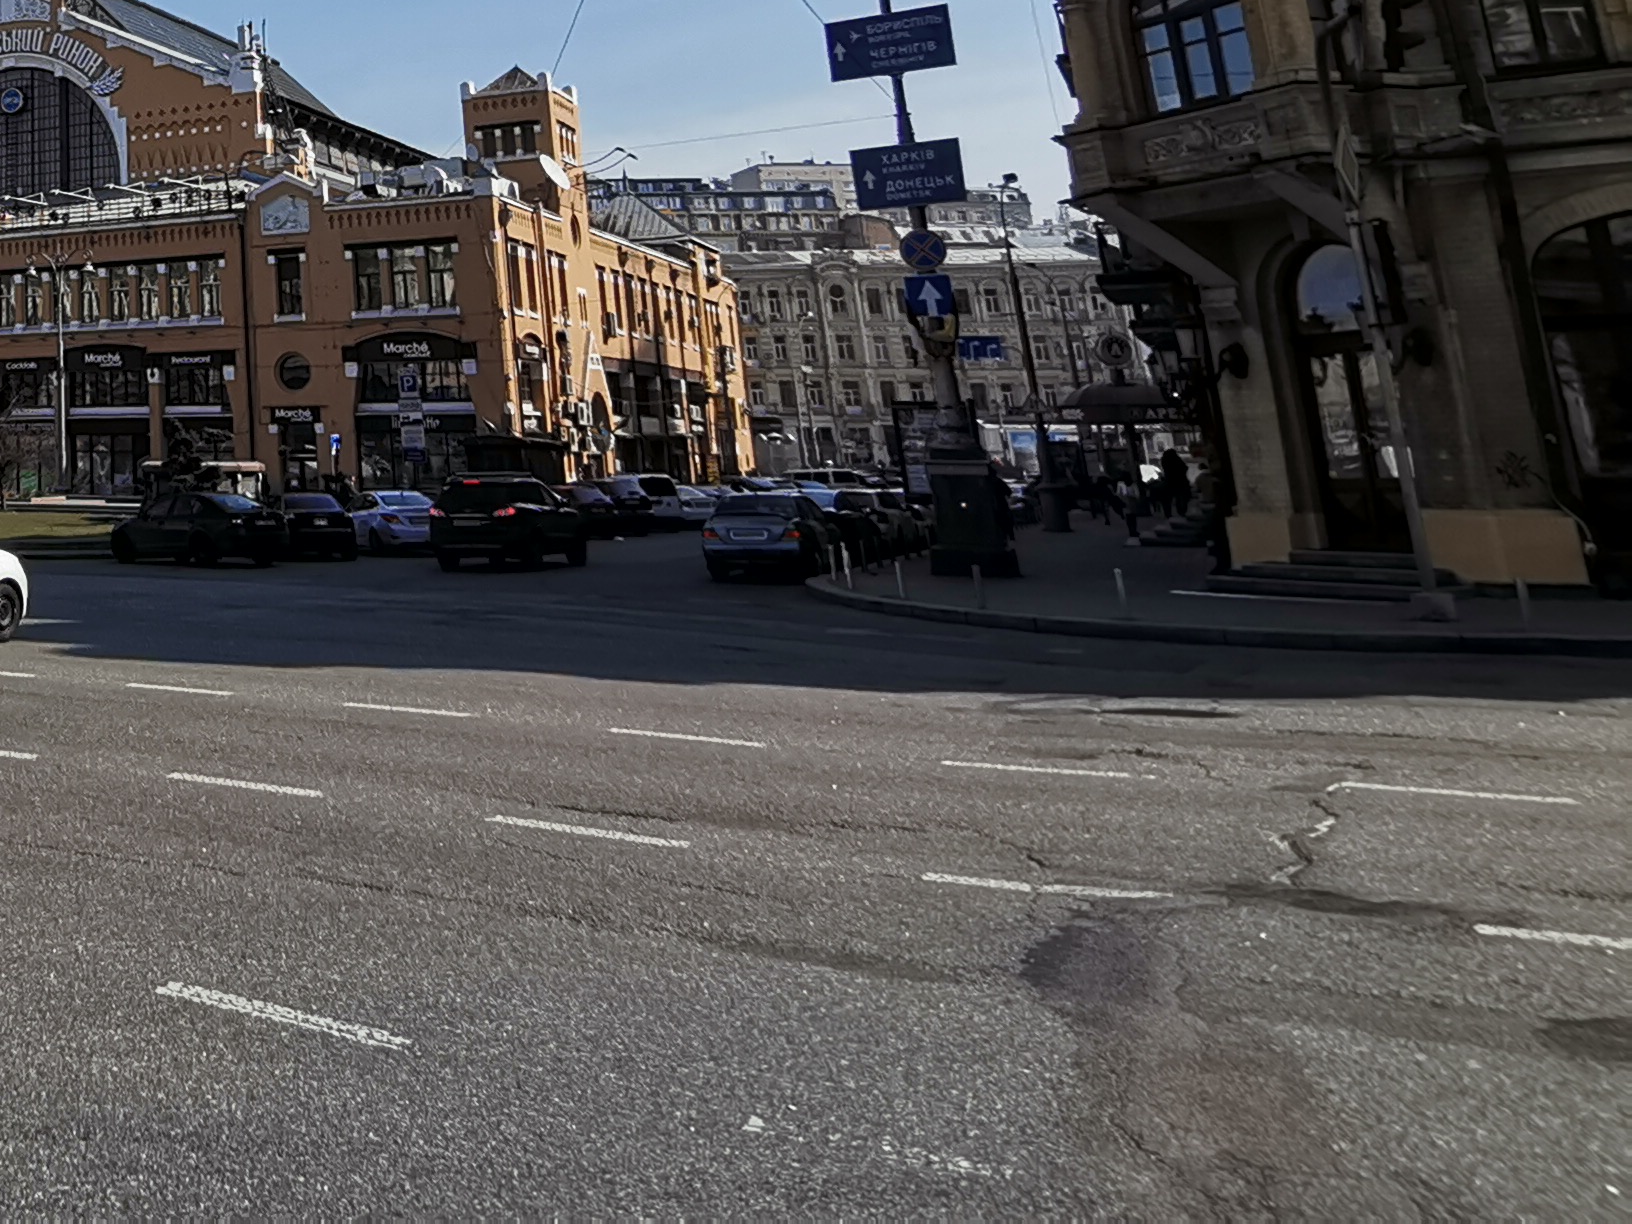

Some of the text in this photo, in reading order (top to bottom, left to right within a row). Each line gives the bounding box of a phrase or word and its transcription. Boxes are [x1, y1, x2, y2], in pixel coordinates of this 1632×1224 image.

[866, 15, 942, 34] БОРИСПІЛЬ
[49, 32, 104, 78] РИНОК
[869, 40, 937, 59] ЧЕРНІГІВ
[881, 149, 935, 165] ХАРКІВ
[886, 174, 956, 192] ДОНЕЦЬК
